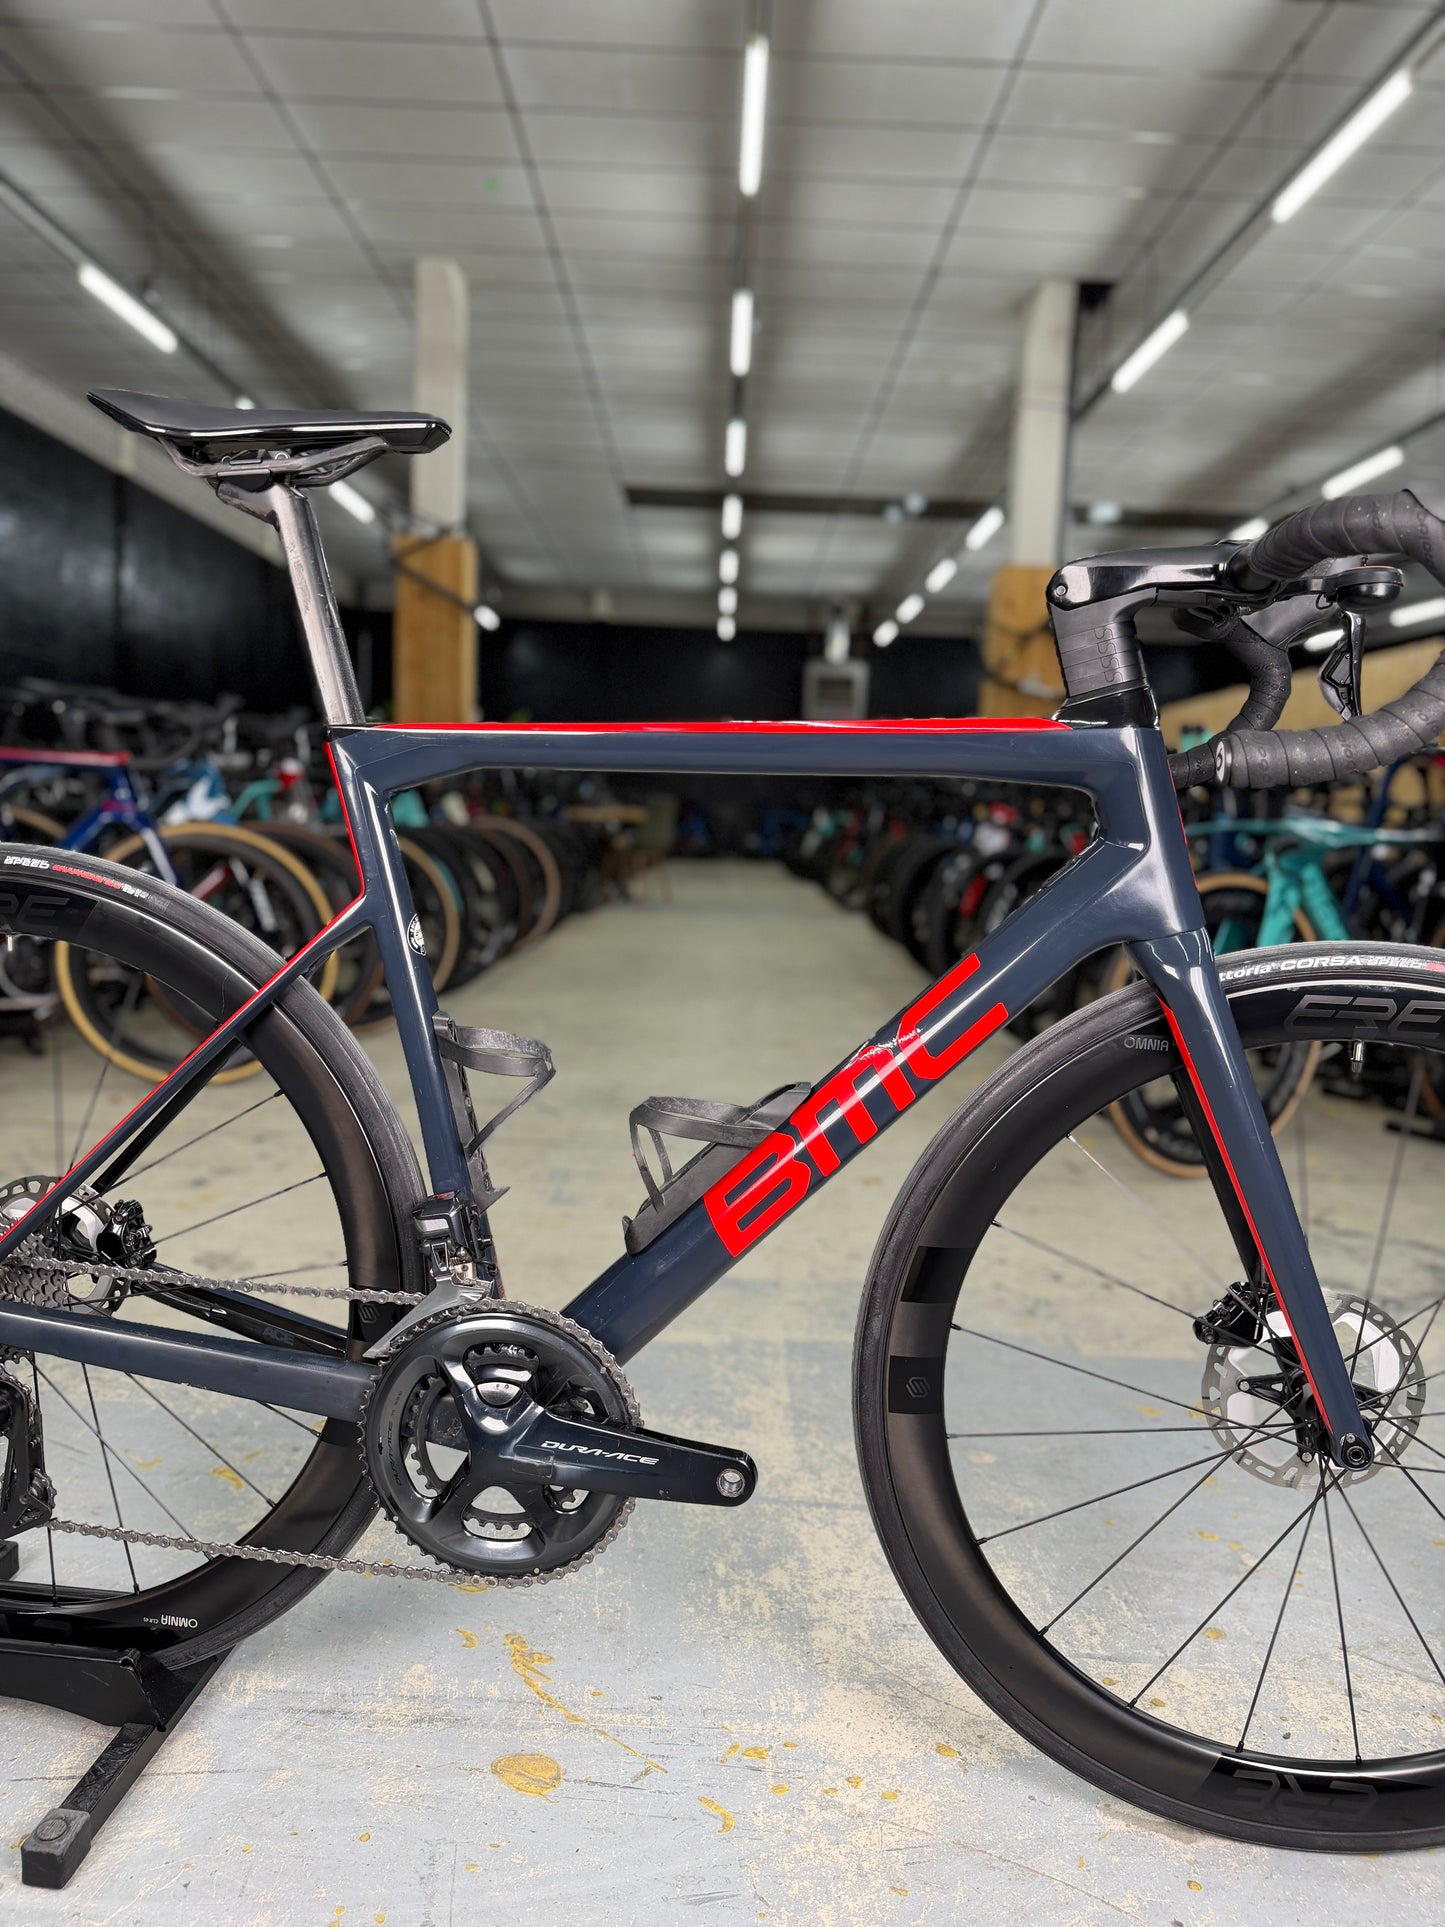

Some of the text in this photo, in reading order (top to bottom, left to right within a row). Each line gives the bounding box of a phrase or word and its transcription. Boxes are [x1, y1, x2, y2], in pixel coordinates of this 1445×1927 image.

[1218, 964, 1272, 981] ttoria
[1280, 955, 1361, 970] CORSA
[1124, 1036, 1169, 1051] OMNIA
[541, 1440, 660, 1465] DURA-ACE
[161, 1614, 198, 1629] OMNIA
